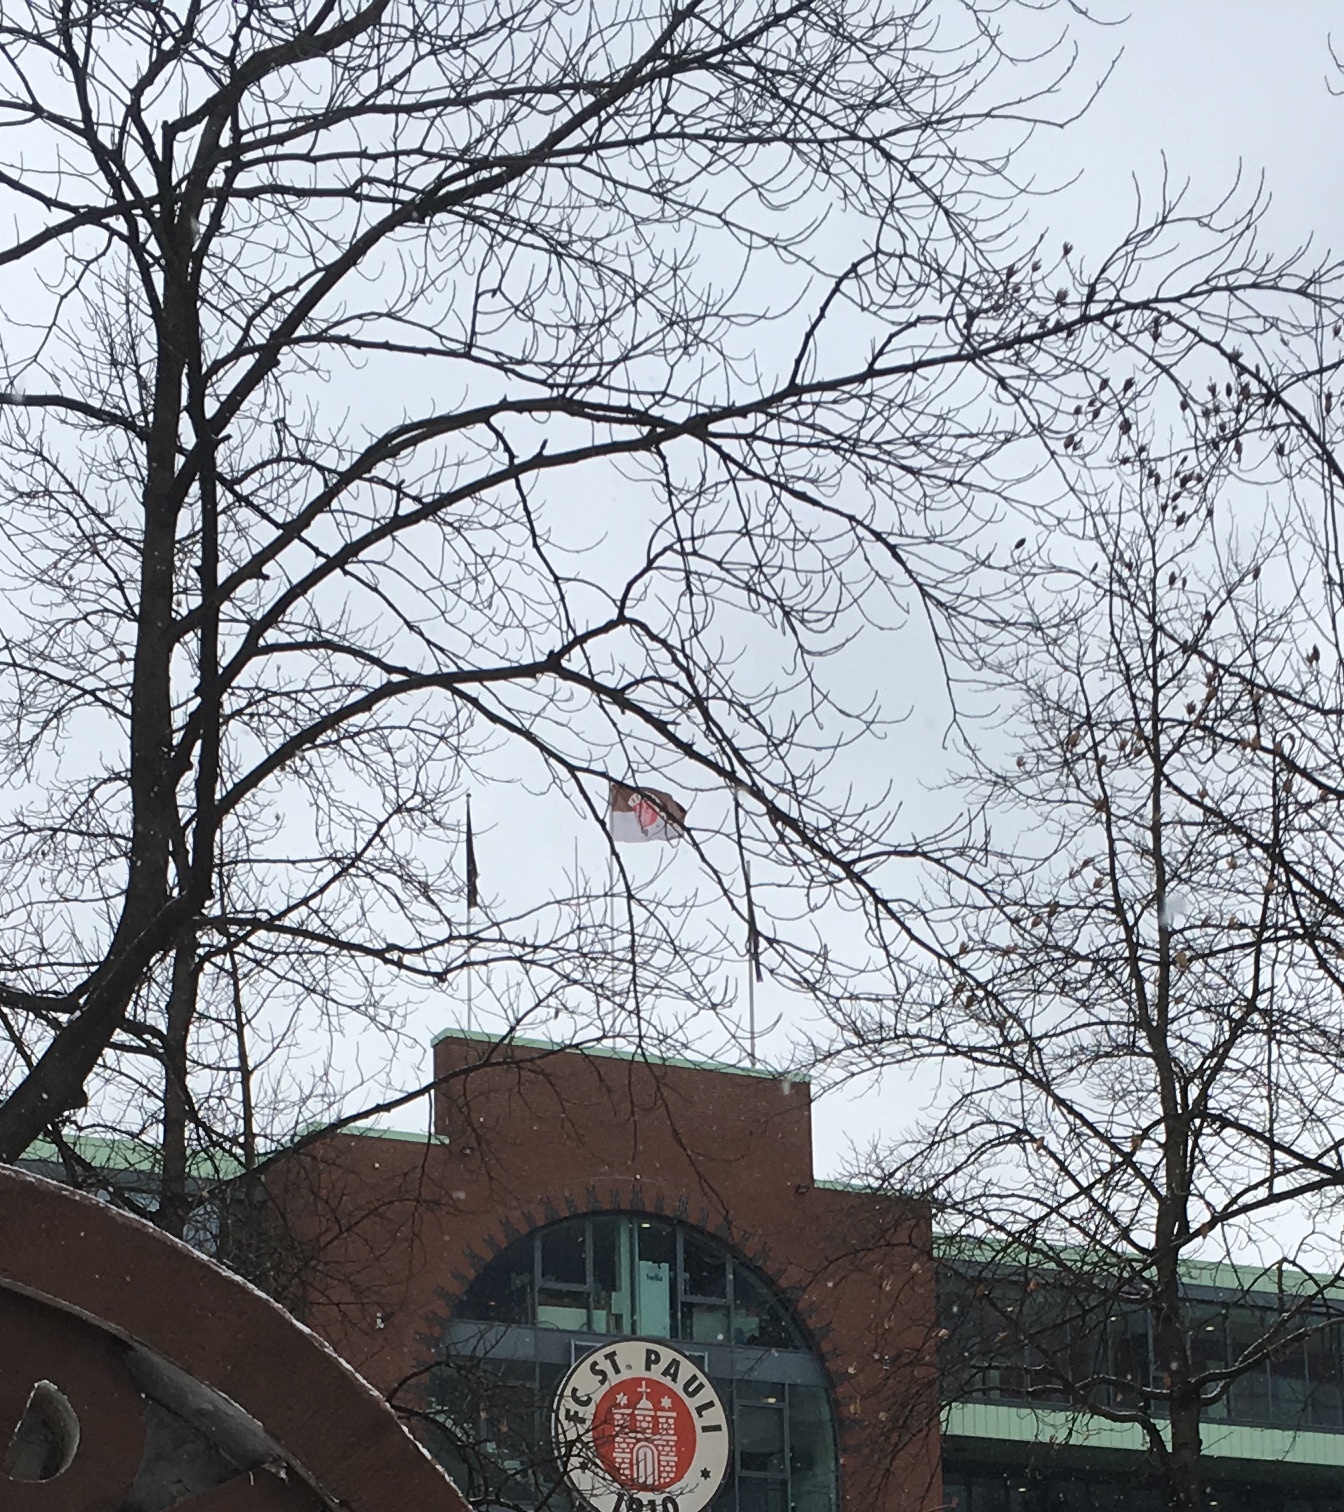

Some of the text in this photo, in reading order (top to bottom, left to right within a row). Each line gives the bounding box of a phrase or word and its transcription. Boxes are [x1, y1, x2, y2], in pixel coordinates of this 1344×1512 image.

[565, 1348, 723, 1434] FC ST. PAULI
